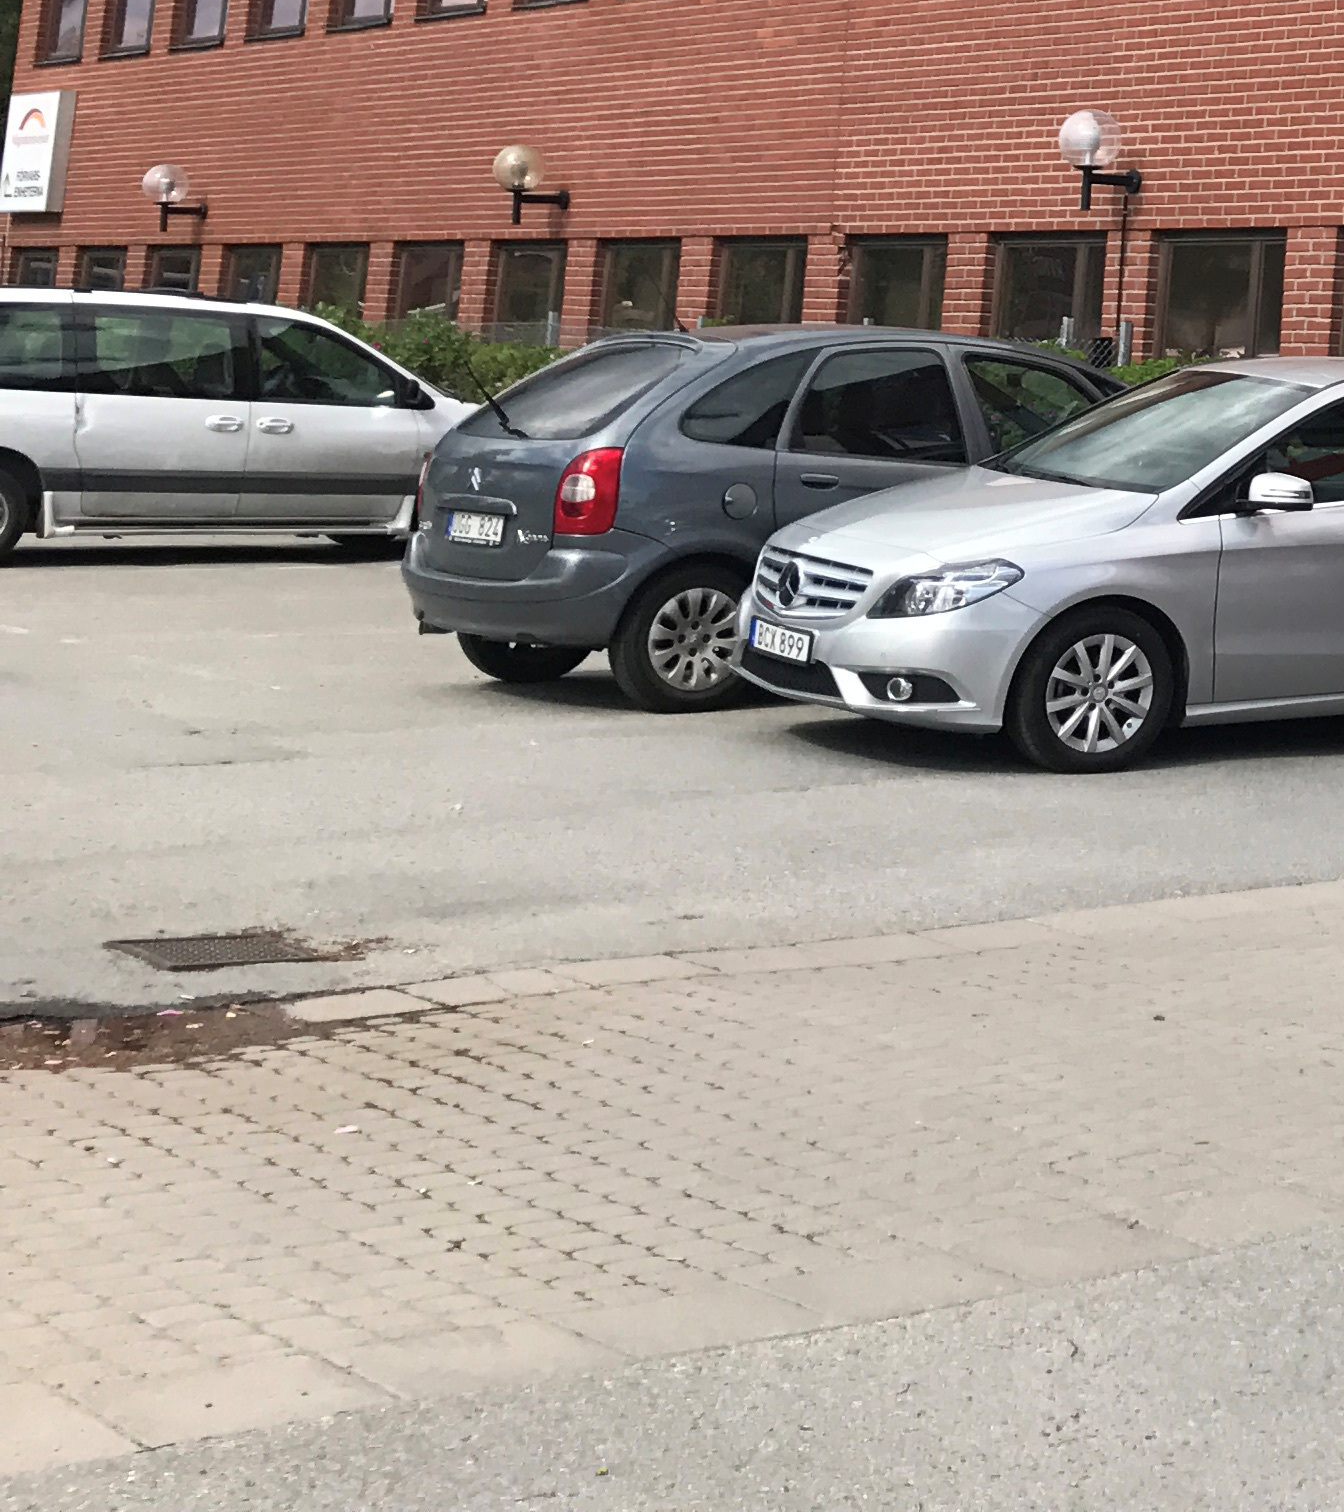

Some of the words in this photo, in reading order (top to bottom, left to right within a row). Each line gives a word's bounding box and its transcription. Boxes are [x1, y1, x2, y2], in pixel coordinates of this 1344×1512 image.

[478, 515, 500, 538] 824
[757, 623, 777, 651] BCX
[779, 631, 805, 659] 899
